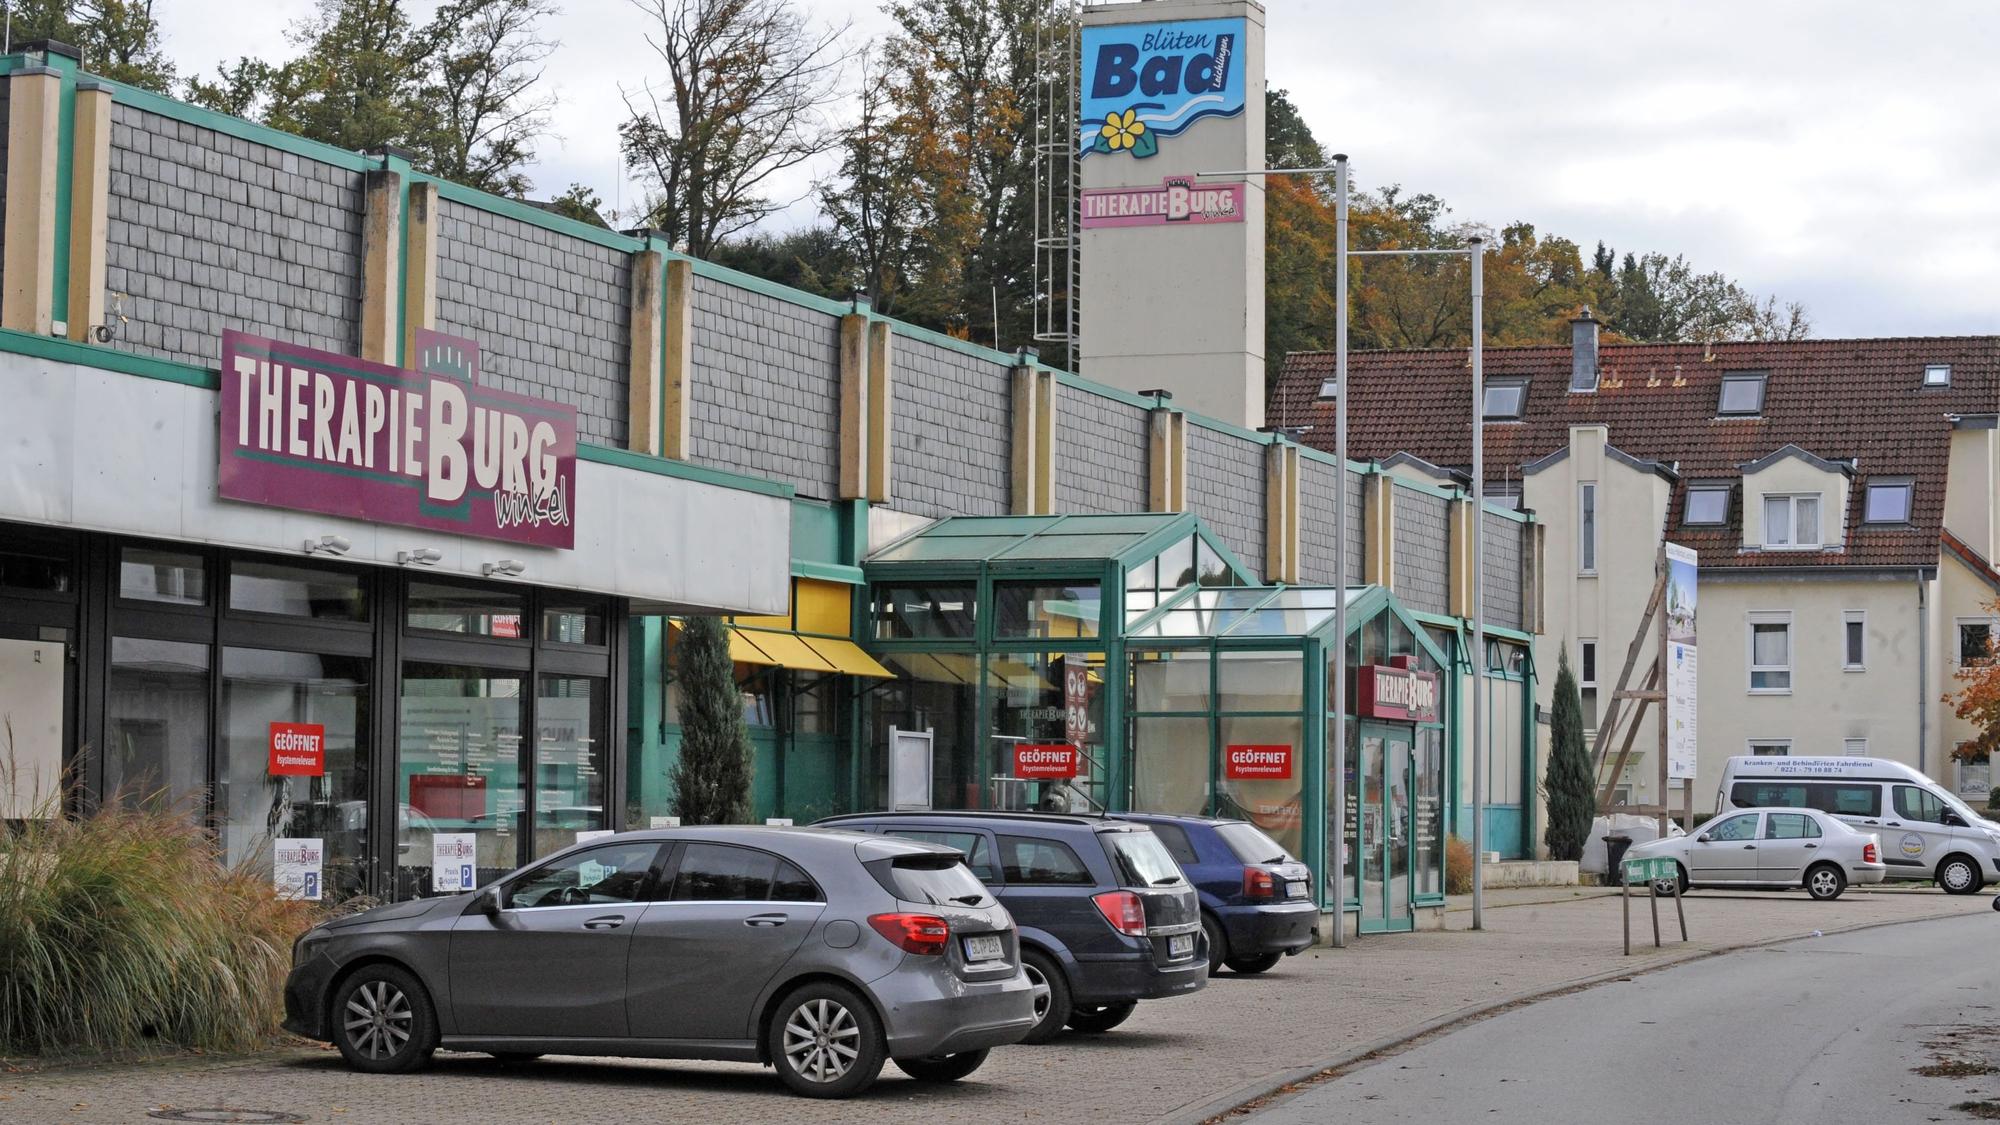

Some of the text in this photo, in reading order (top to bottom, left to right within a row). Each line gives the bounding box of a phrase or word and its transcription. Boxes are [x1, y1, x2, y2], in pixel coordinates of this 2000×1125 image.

[1142, 28, 1212, 52] Blüten
[1091, 33, 1235, 99] Bad
[1212, 36, 1231, 89] Leichlingen
[274, 729, 321, 752] GEÖFFNET
[276, 754, 317, 767] #systemrelevant
[1019, 748, 1072, 763] GEÖFFNET
[1232, 749, 1286, 764] GEÖFFNET
[1022, 765, 1068, 773] #systemrelevant
[1235, 765, 1282, 774] #systemrelevant
